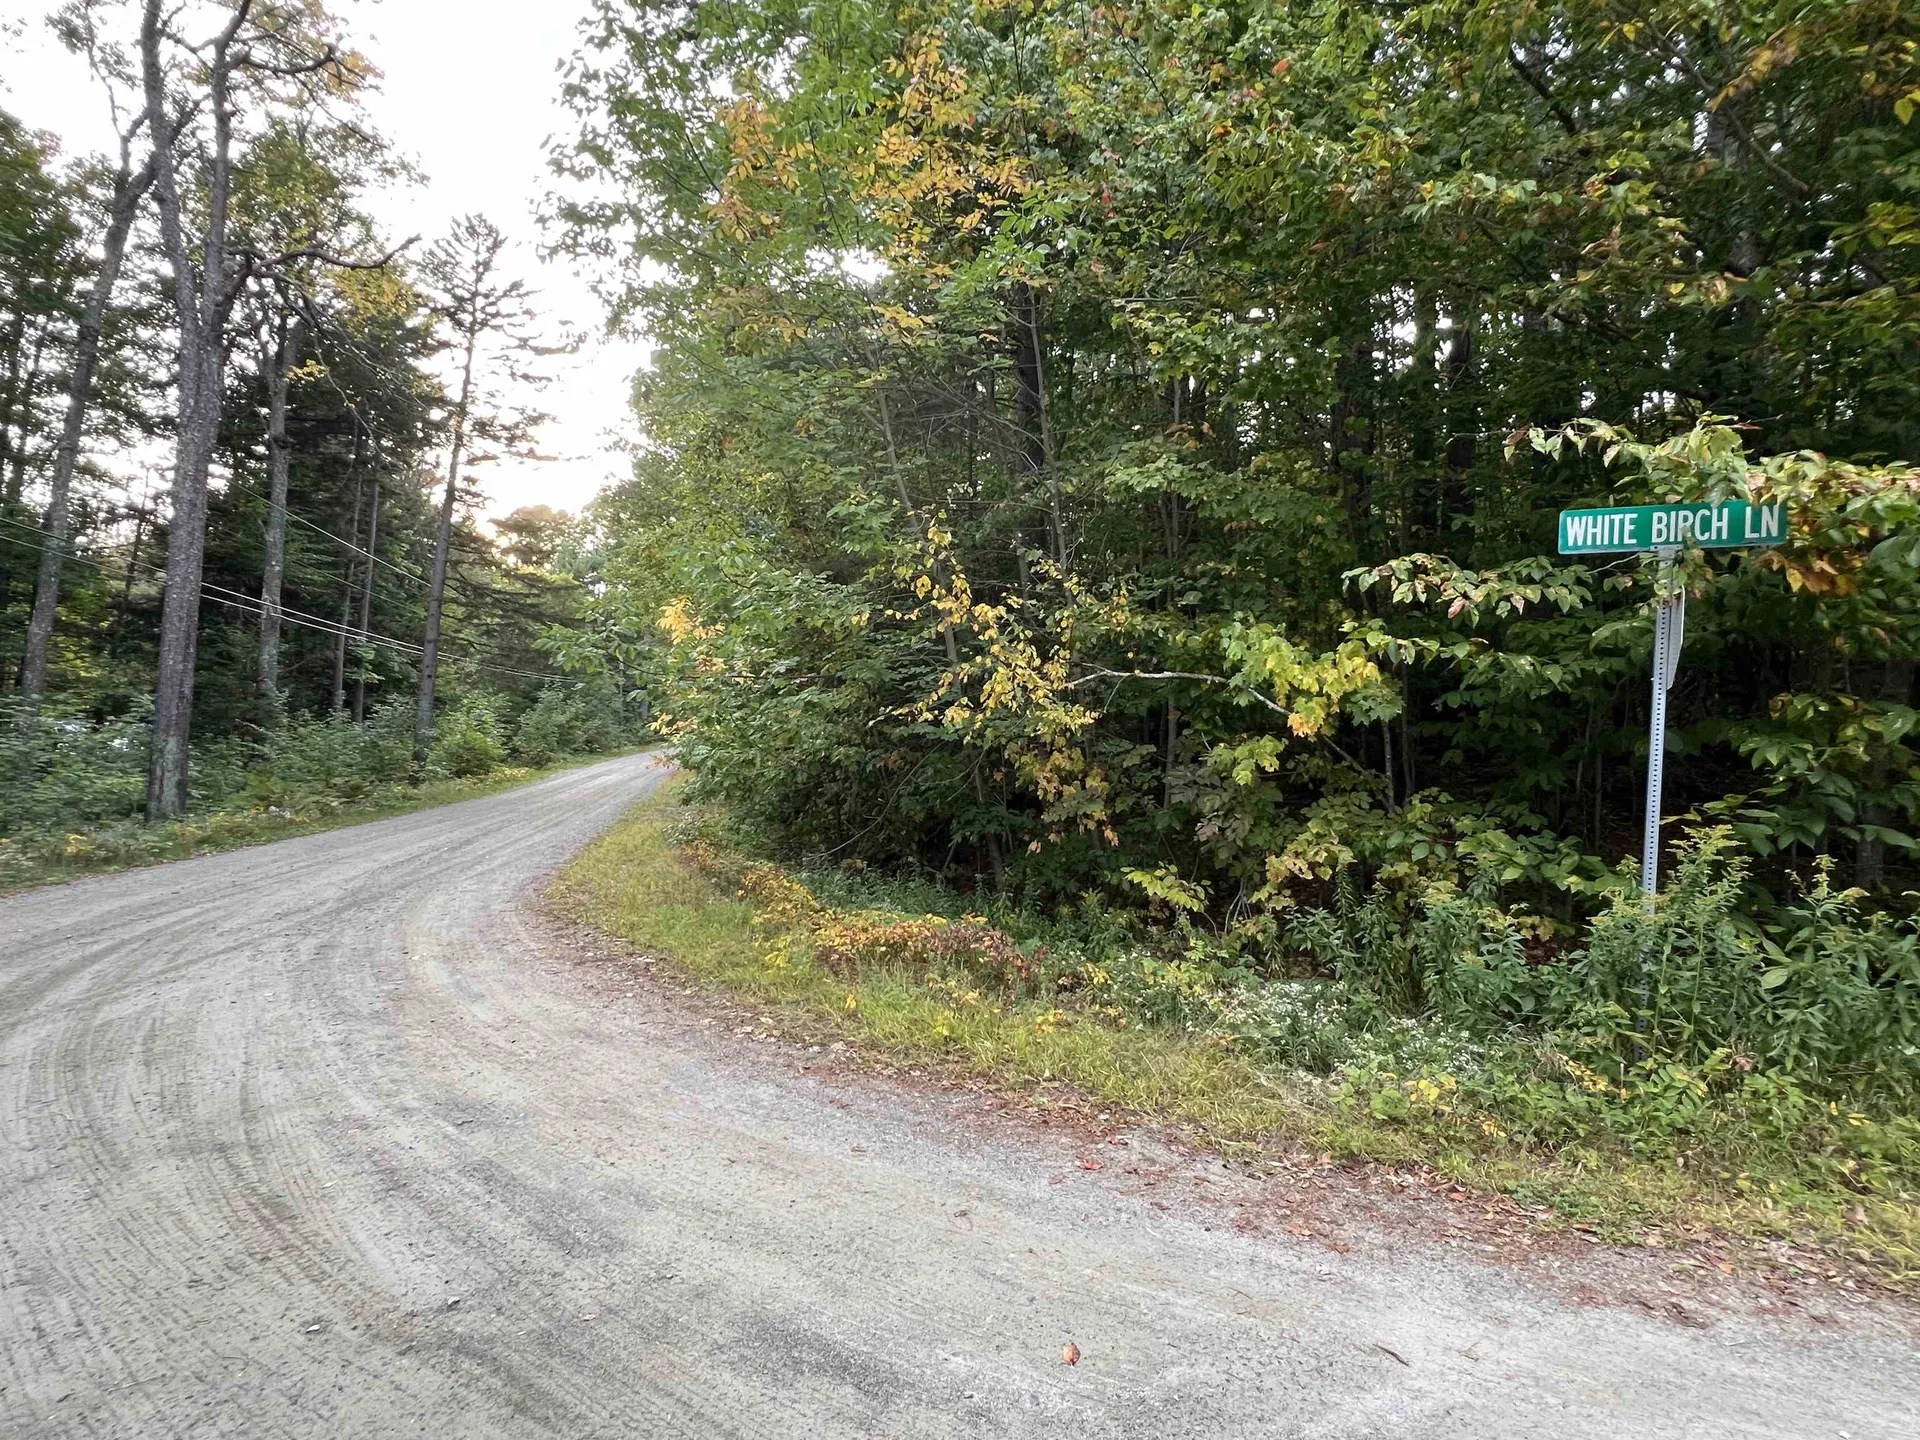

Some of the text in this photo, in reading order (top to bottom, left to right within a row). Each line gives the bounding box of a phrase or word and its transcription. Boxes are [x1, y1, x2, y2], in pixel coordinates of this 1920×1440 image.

[1566, 504, 1779, 547] WHITE BIRCH LN
